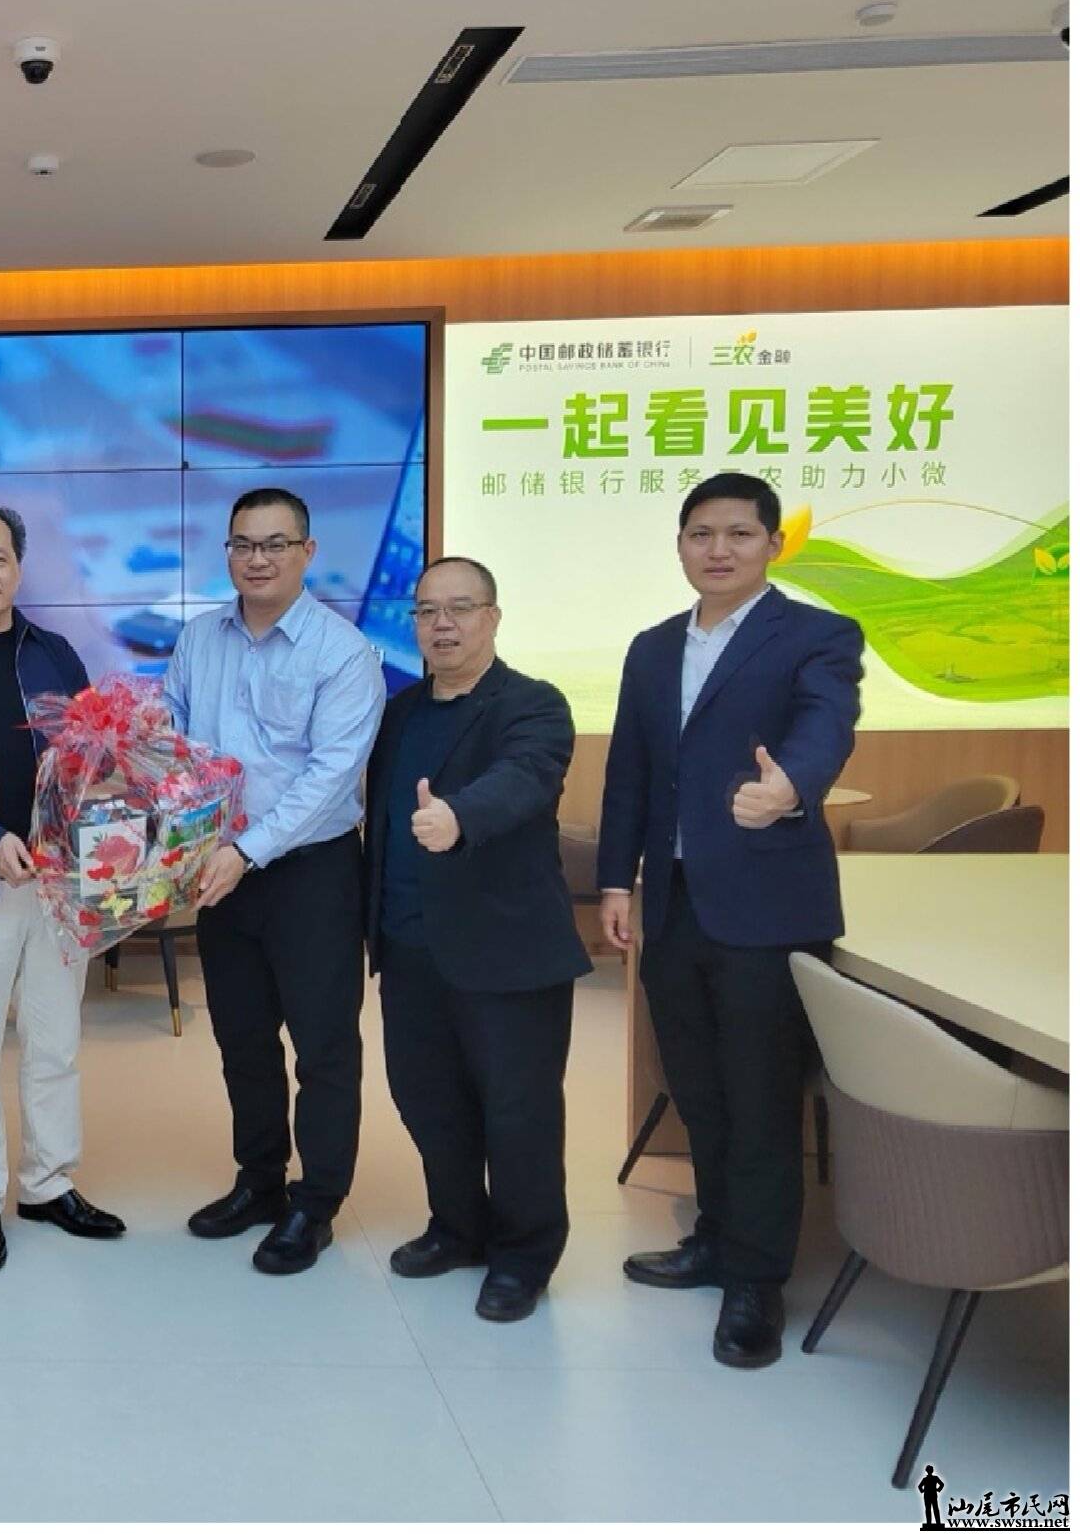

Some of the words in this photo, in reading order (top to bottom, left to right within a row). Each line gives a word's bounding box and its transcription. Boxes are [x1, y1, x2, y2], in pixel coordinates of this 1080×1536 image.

[518, 340, 671, 361] 中国邮政储蓄银行
[482, 384, 954, 460] 一起看见美好
